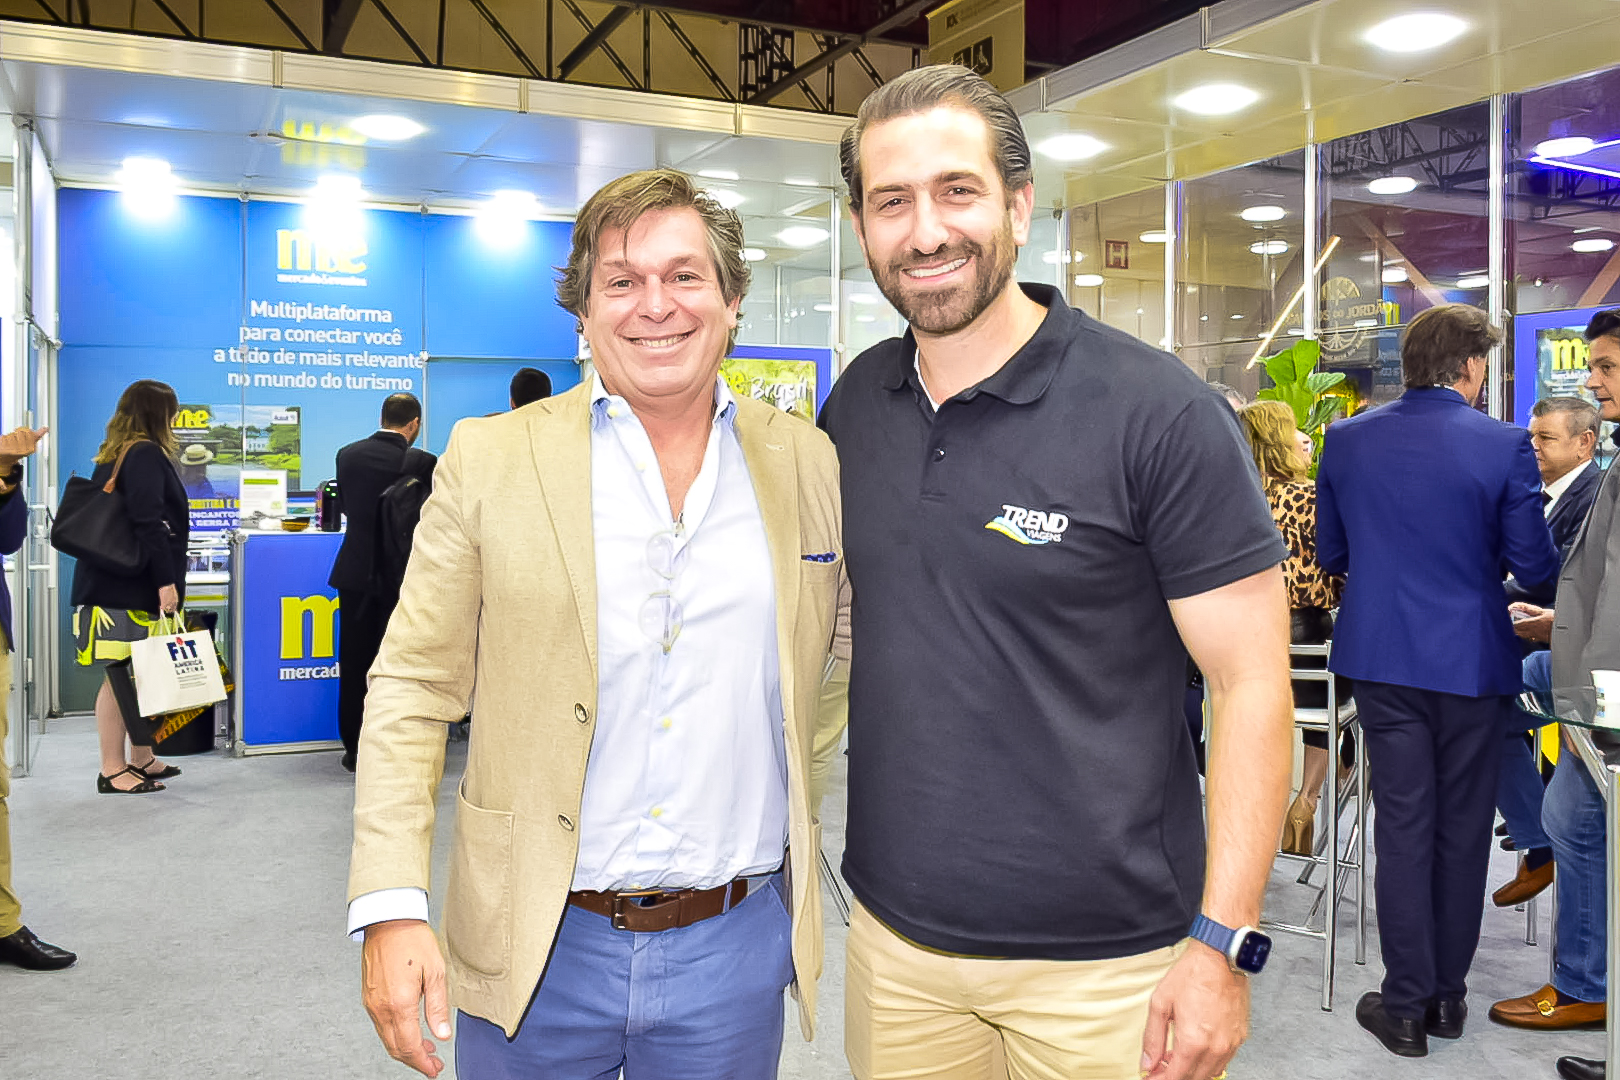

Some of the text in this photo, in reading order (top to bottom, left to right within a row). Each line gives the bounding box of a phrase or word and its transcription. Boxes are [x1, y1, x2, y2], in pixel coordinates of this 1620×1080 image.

[250, 299, 393, 324] Multiplataforma
[239, 326, 402, 346] para conectar você
[213, 348, 226, 363] a
[273, 347, 296, 365] de
[299, 348, 342, 367] mais
[345, 350, 424, 369] relevante
[227, 371, 413, 391] no mundo do turismo
[1001, 504, 1069, 534] TREND
[279, 661, 340, 680] mercad
